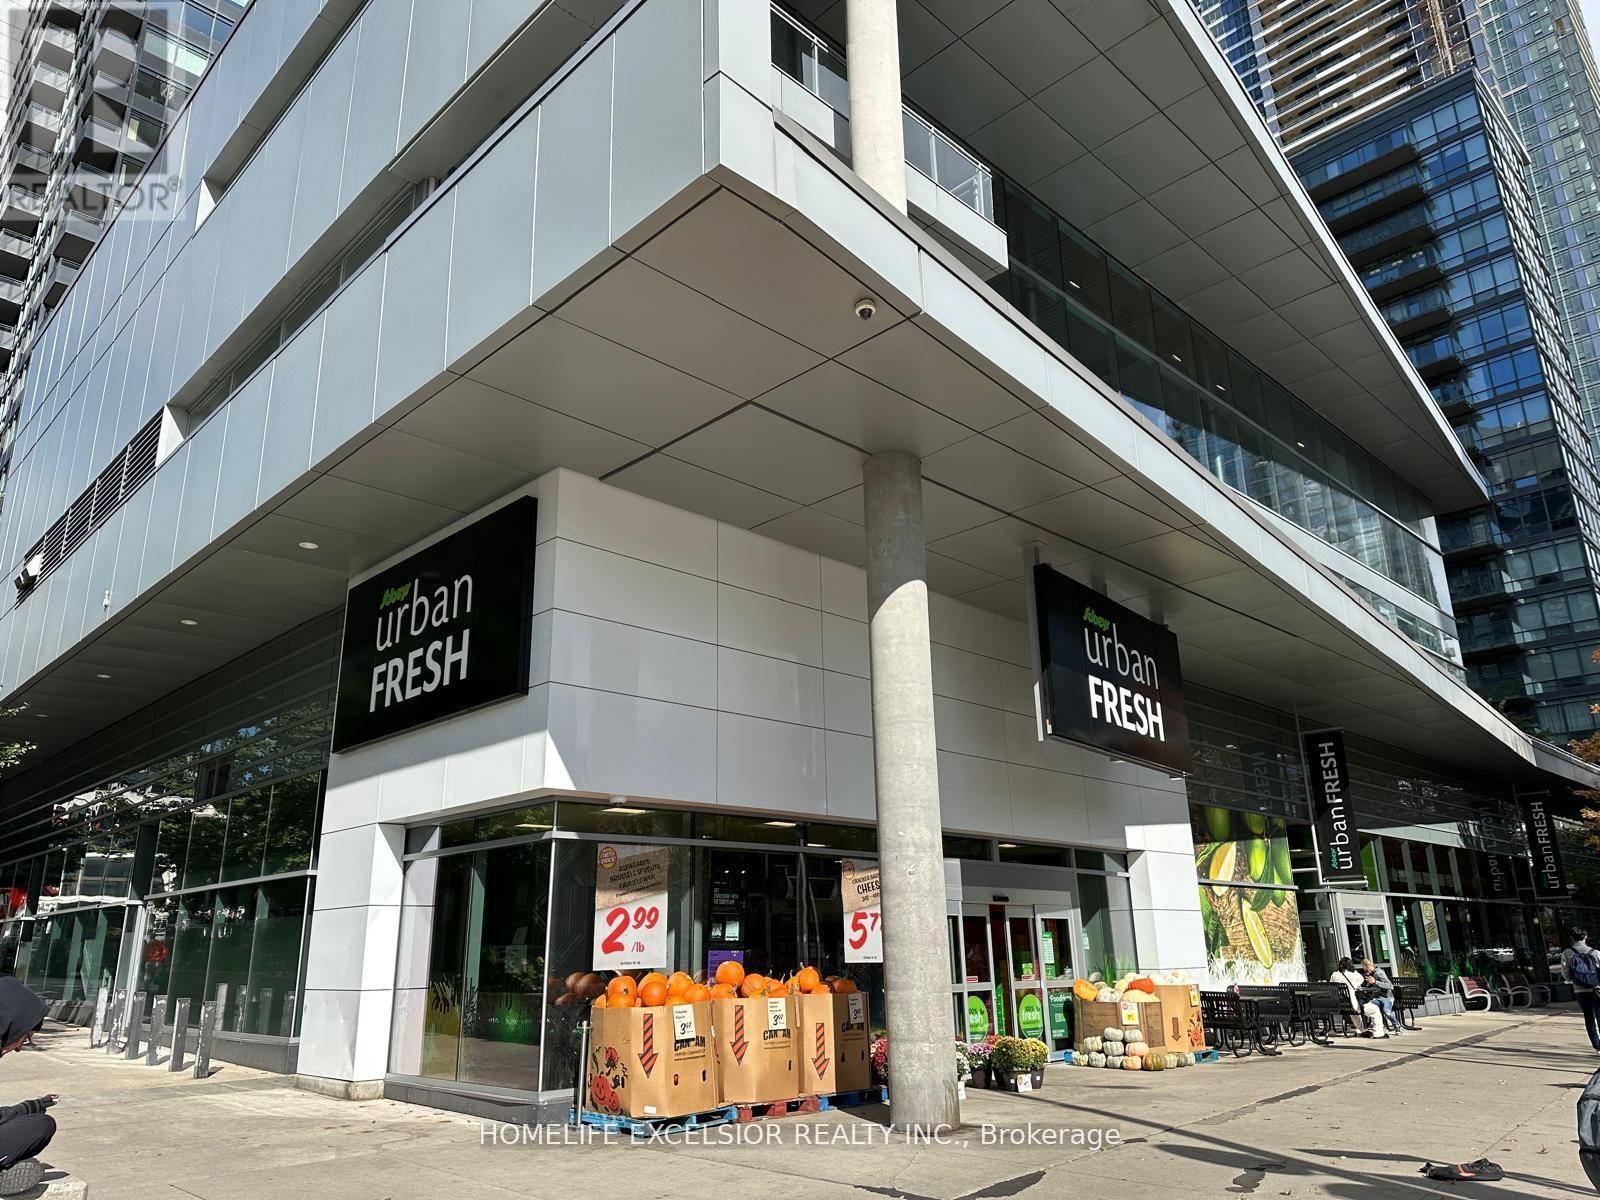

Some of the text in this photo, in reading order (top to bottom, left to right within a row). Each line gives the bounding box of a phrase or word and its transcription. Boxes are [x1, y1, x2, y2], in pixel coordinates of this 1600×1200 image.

[376, 574, 473, 651] urban
[369, 628, 470, 713] FRESH
[1084, 622, 1159, 690] urban
[1088, 674, 1166, 742] FRESH
